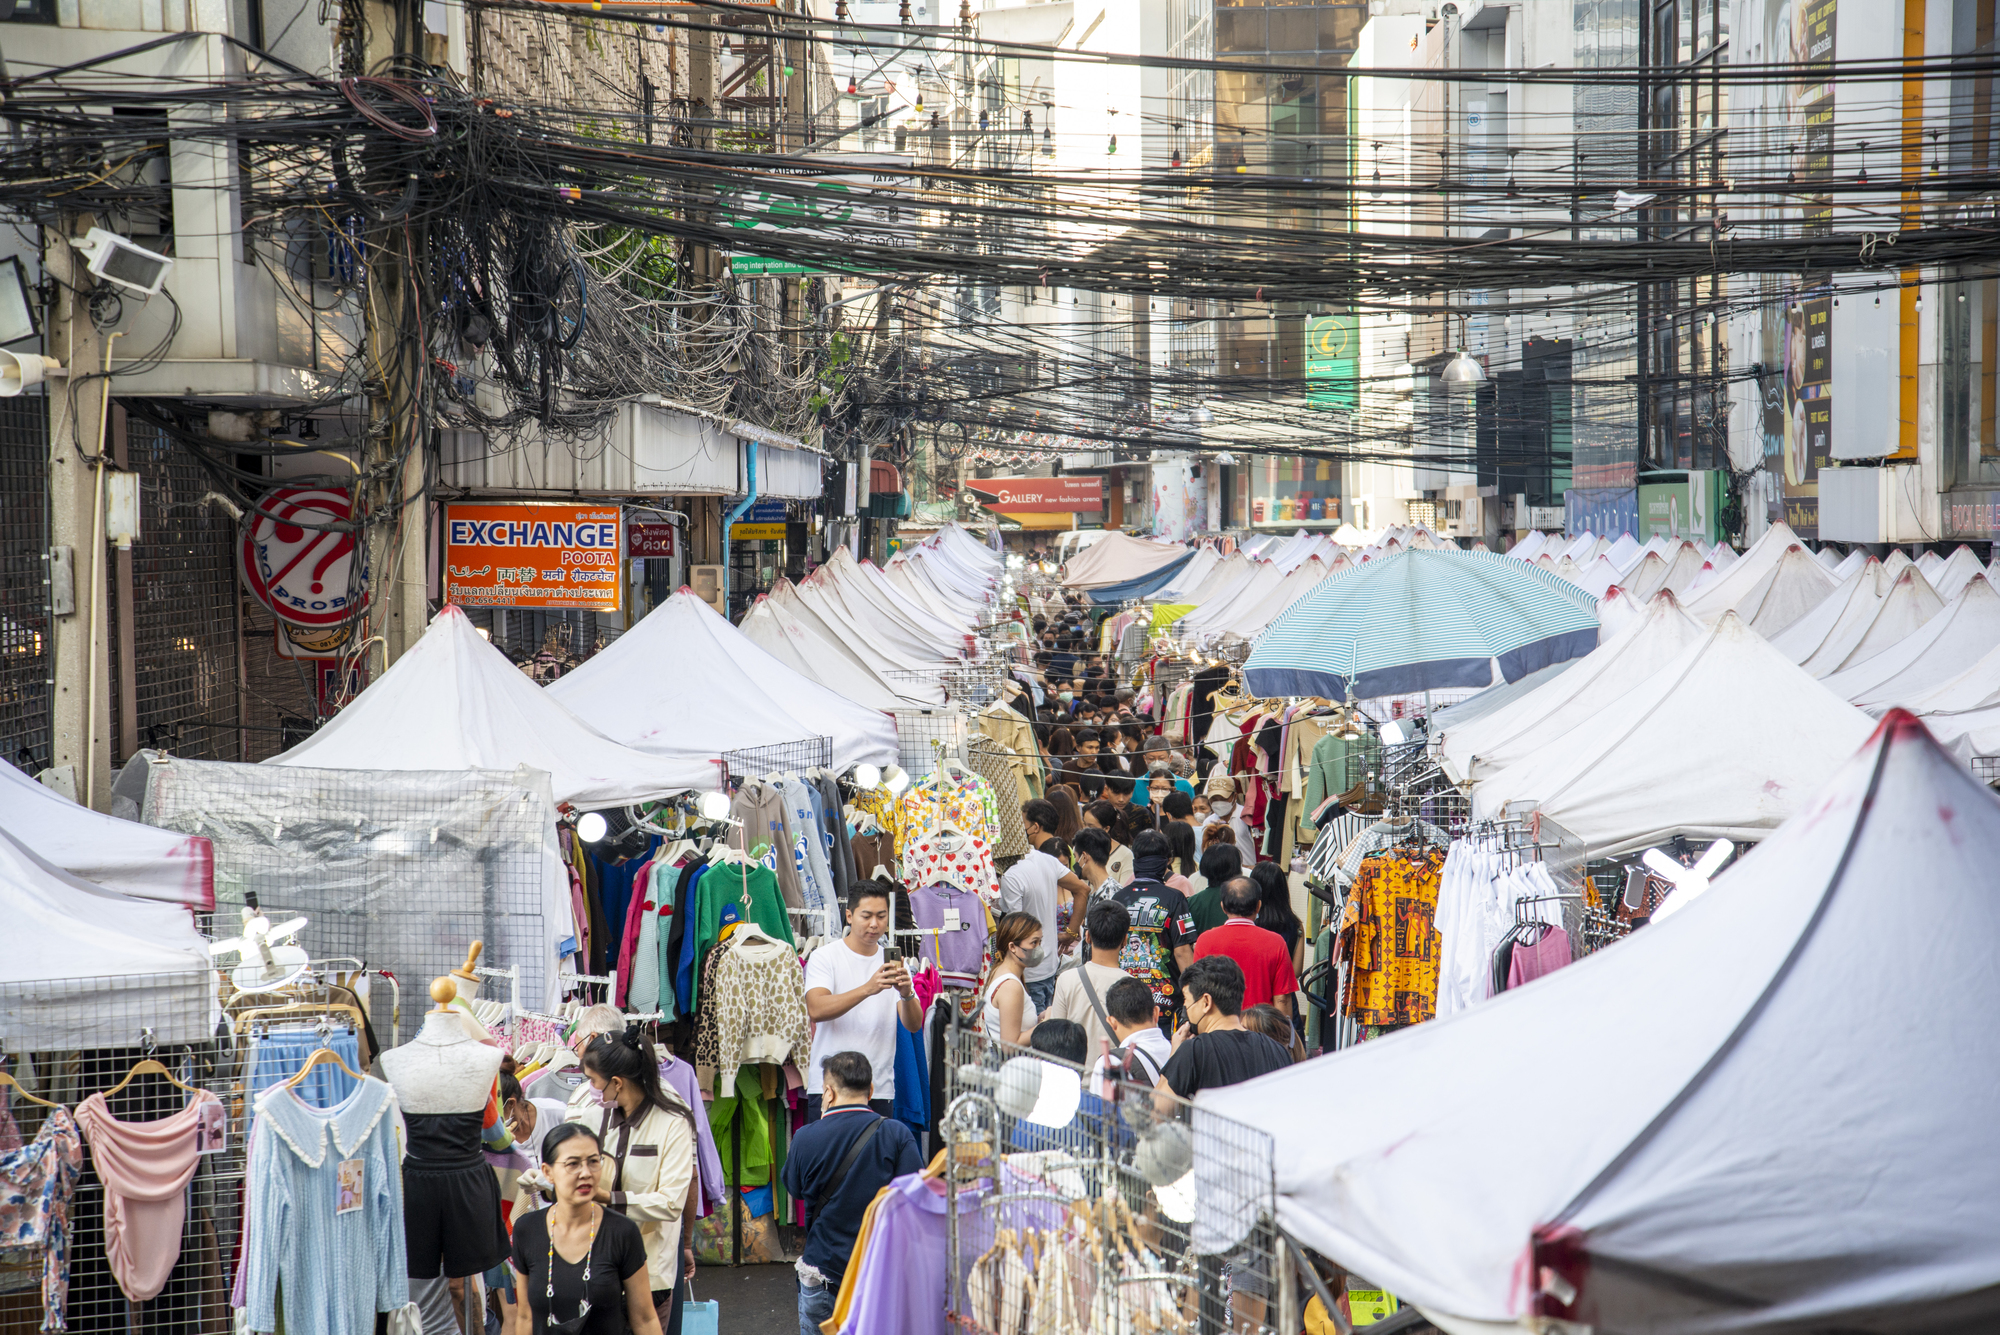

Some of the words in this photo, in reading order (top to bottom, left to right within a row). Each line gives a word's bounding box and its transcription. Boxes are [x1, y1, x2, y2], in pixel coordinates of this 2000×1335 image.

[1952, 504, 1974, 532] ROCK
[449, 519, 617, 549] EXCHANGE
[561, 551, 616, 566] POOTA
[449, 564, 491, 578] صرافة
[496, 566, 537, 584] 両替
[542, 566, 567, 582] मनी
[449, 582, 614, 599] รับแลกเปลี่ยนเงินตราต่างประเทศ
[450, 596, 464, 604] Tel.
[464, 597, 516, 605] 02-656-4411
